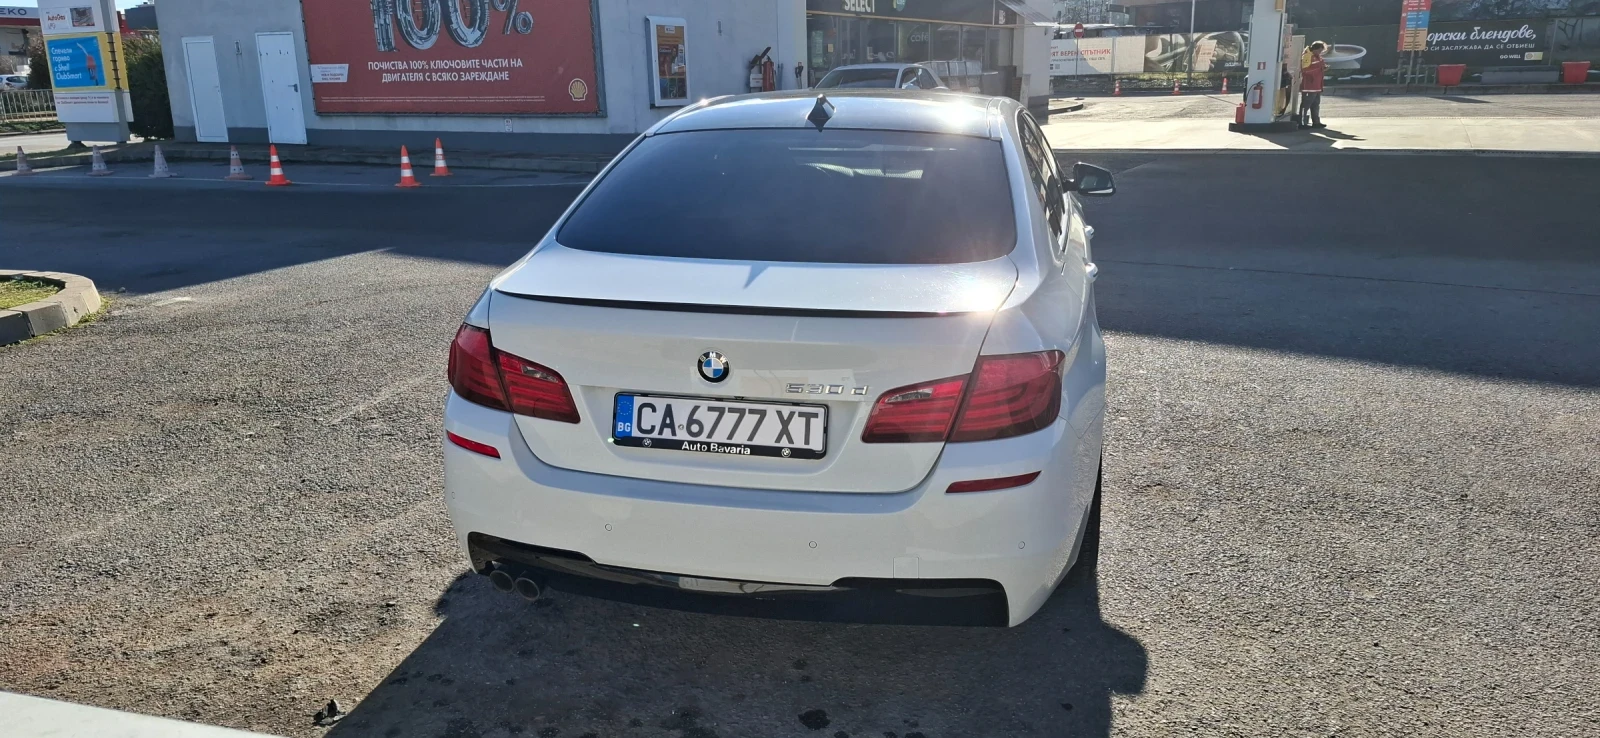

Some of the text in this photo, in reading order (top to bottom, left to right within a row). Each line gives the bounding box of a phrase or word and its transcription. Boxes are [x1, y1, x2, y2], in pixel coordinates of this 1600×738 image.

[1470, 24, 1536, 43] блендове,
[1081, 48, 1111, 56] СПЪТНИК
[58, 63, 70, 71] Shell
[368, 58, 523, 70] ПОЧИСТВА 100% КЛЮЧОВИТЕ ЧАСТИ НА
[56, 72, 82, 80] ClubSmart
[382, 71, 510, 83] ДВИГАТЕЛЯ С ВСЯКО ЗАРЕЖДАНЕ
[786, 382, 869, 396] 530 d
[617, 402, 819, 446] BG CA 6777 XT
[681, 441, 751, 455] Auto Bavaria
